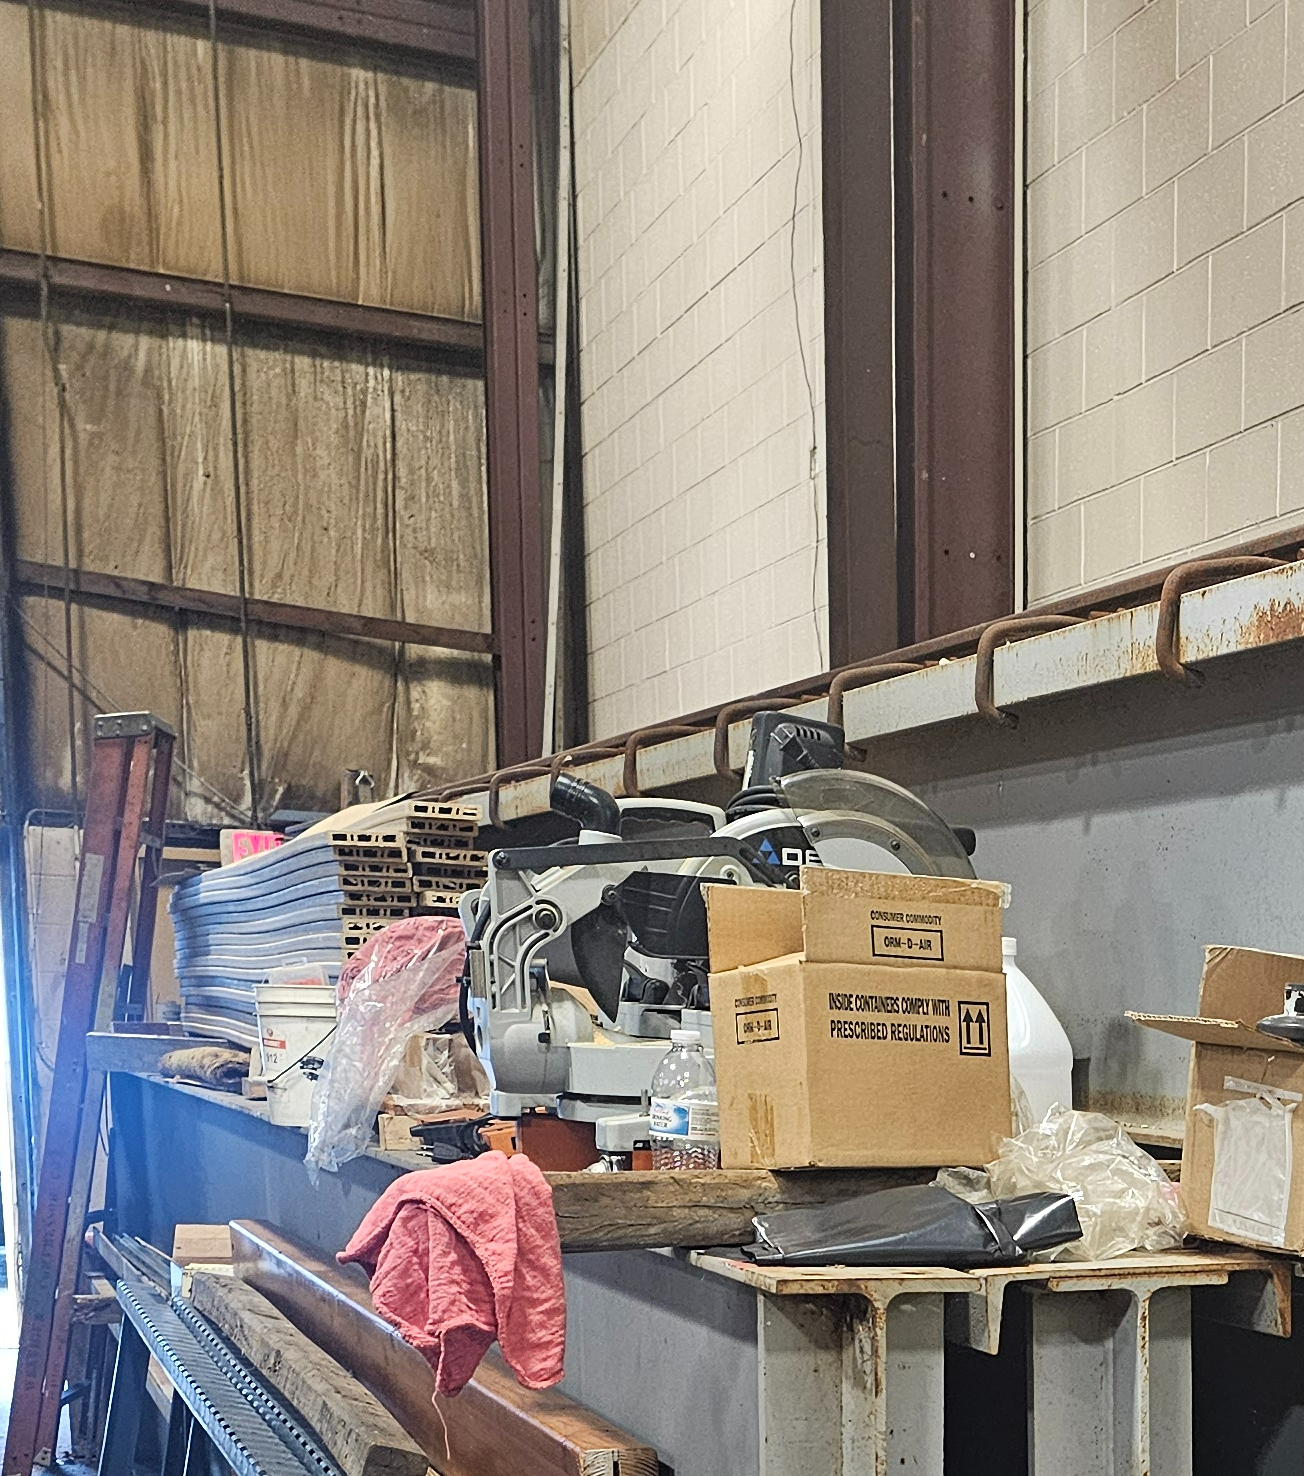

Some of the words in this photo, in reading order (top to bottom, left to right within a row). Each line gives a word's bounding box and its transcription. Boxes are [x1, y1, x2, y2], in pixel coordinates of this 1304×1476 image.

[870, 910, 904, 923] CONSUMER
[905, 913, 942, 925] COMMODITY
[884, 936, 932, 951] ORM-D-AIR
[828, 992, 854, 1011] INSIDE
[854, 994, 900, 1014] CONTAINERS
[901, 996, 930, 1015] COMPLY
[930, 998, 951, 1017] WITH
[830, 1019, 888, 1041] PRESCRIBED
[890, 1022, 951, 1043] REGULATIONS
